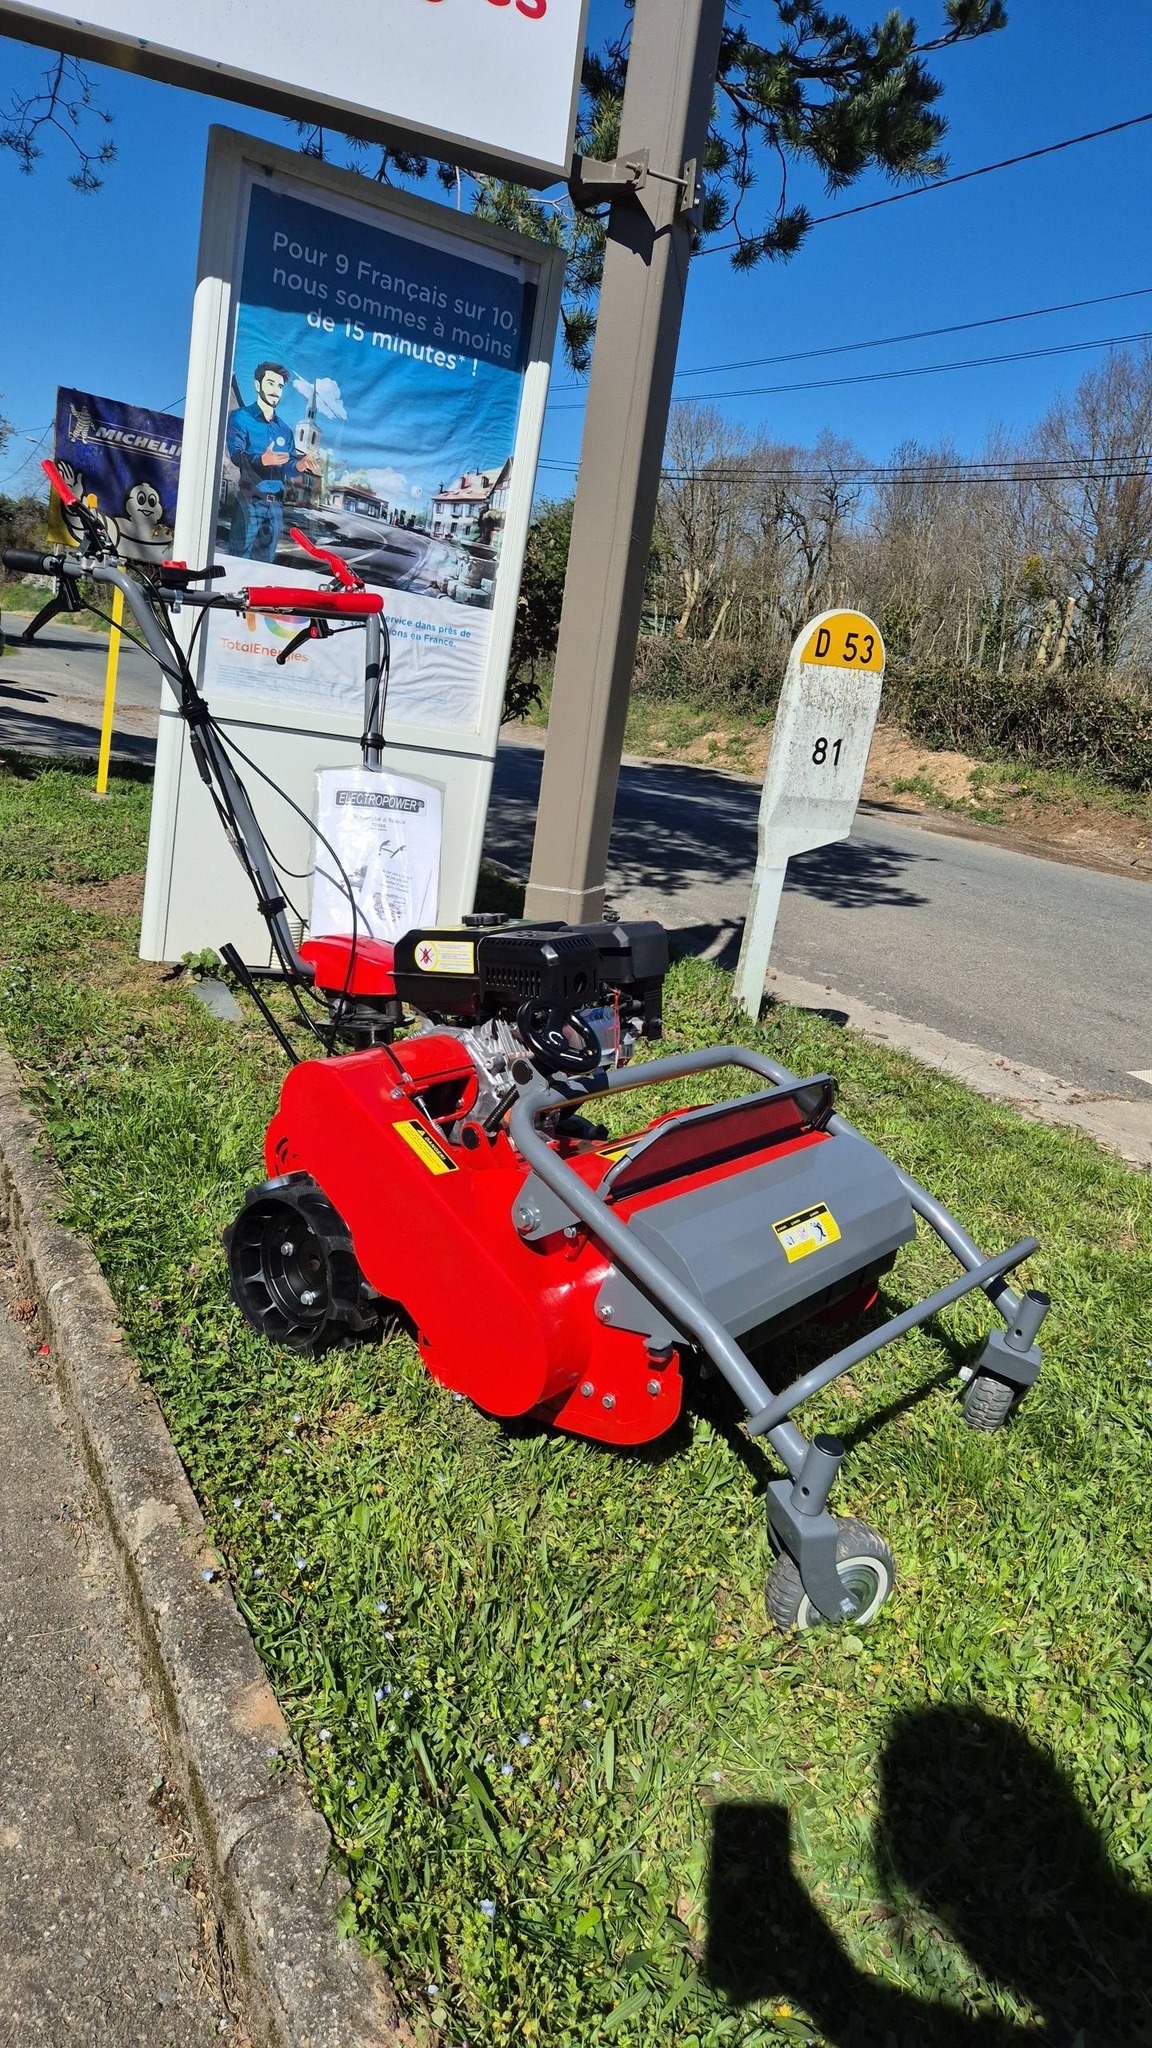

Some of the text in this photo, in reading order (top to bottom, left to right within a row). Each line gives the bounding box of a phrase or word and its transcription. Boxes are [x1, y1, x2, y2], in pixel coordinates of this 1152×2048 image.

[273, 231, 517, 335] Pour 9 Français sur 10,
[272, 267, 512, 359] nous sommes à moins
[306, 307, 335, 333] de
[344, 317, 366, 341] 15
[385, 615, 471, 639] ervice dans près de
[410, 632, 422, 641] en
[423, 634, 456, 647] France.
[815, 628, 875, 664] D 53
[812, 737, 844, 766] 81
